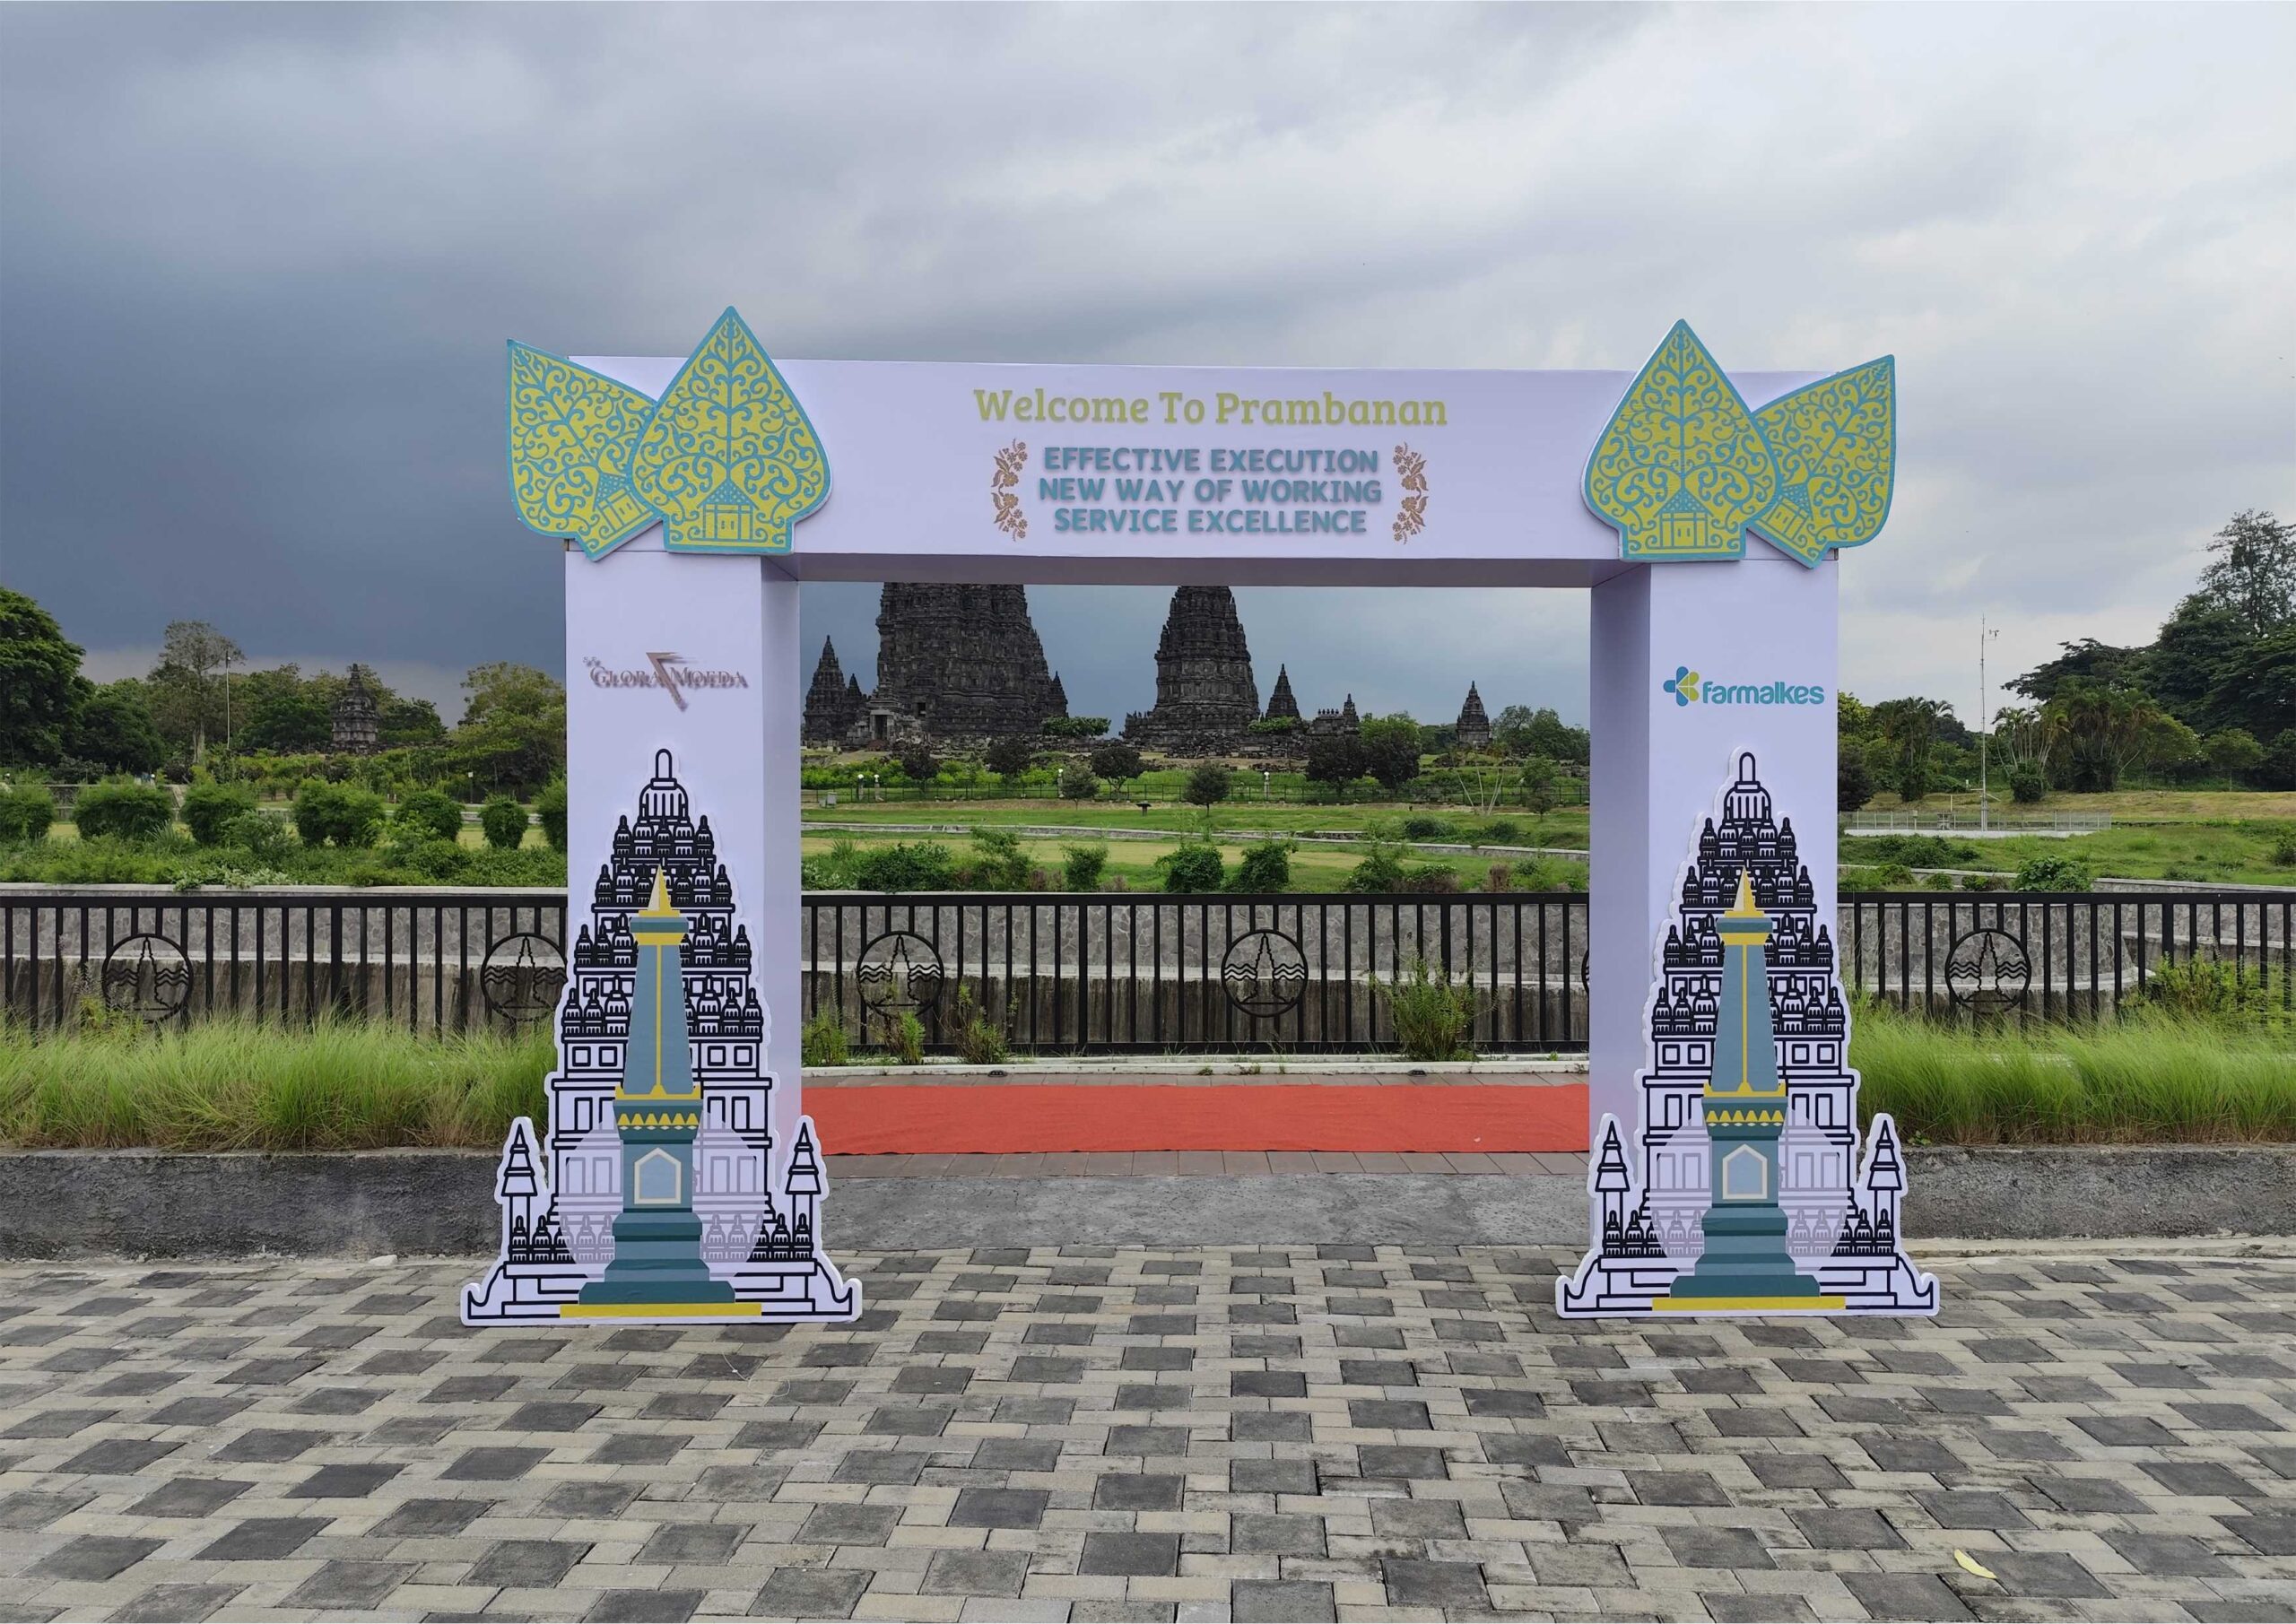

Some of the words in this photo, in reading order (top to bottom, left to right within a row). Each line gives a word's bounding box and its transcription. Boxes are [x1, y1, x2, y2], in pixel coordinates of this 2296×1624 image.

[974, 388, 1148, 423] Welcome
[1160, 392, 1205, 424] To
[1216, 392, 1447, 425] Prambanan
[1045, 447, 1200, 473] EFFECTIVE
[1211, 449, 1378, 474] EXECUTION
[1039, 478, 1105, 501] NEW
[1116, 479, 1184, 502] WAY
[1195, 479, 1232, 504] OF
[1242, 480, 1381, 504] WORKING
[1055, 508, 1178, 533] SERVICE
[1188, 509, 1366, 534] EXCELLENCE
[1703, 682, 1824, 704] farmalkes
